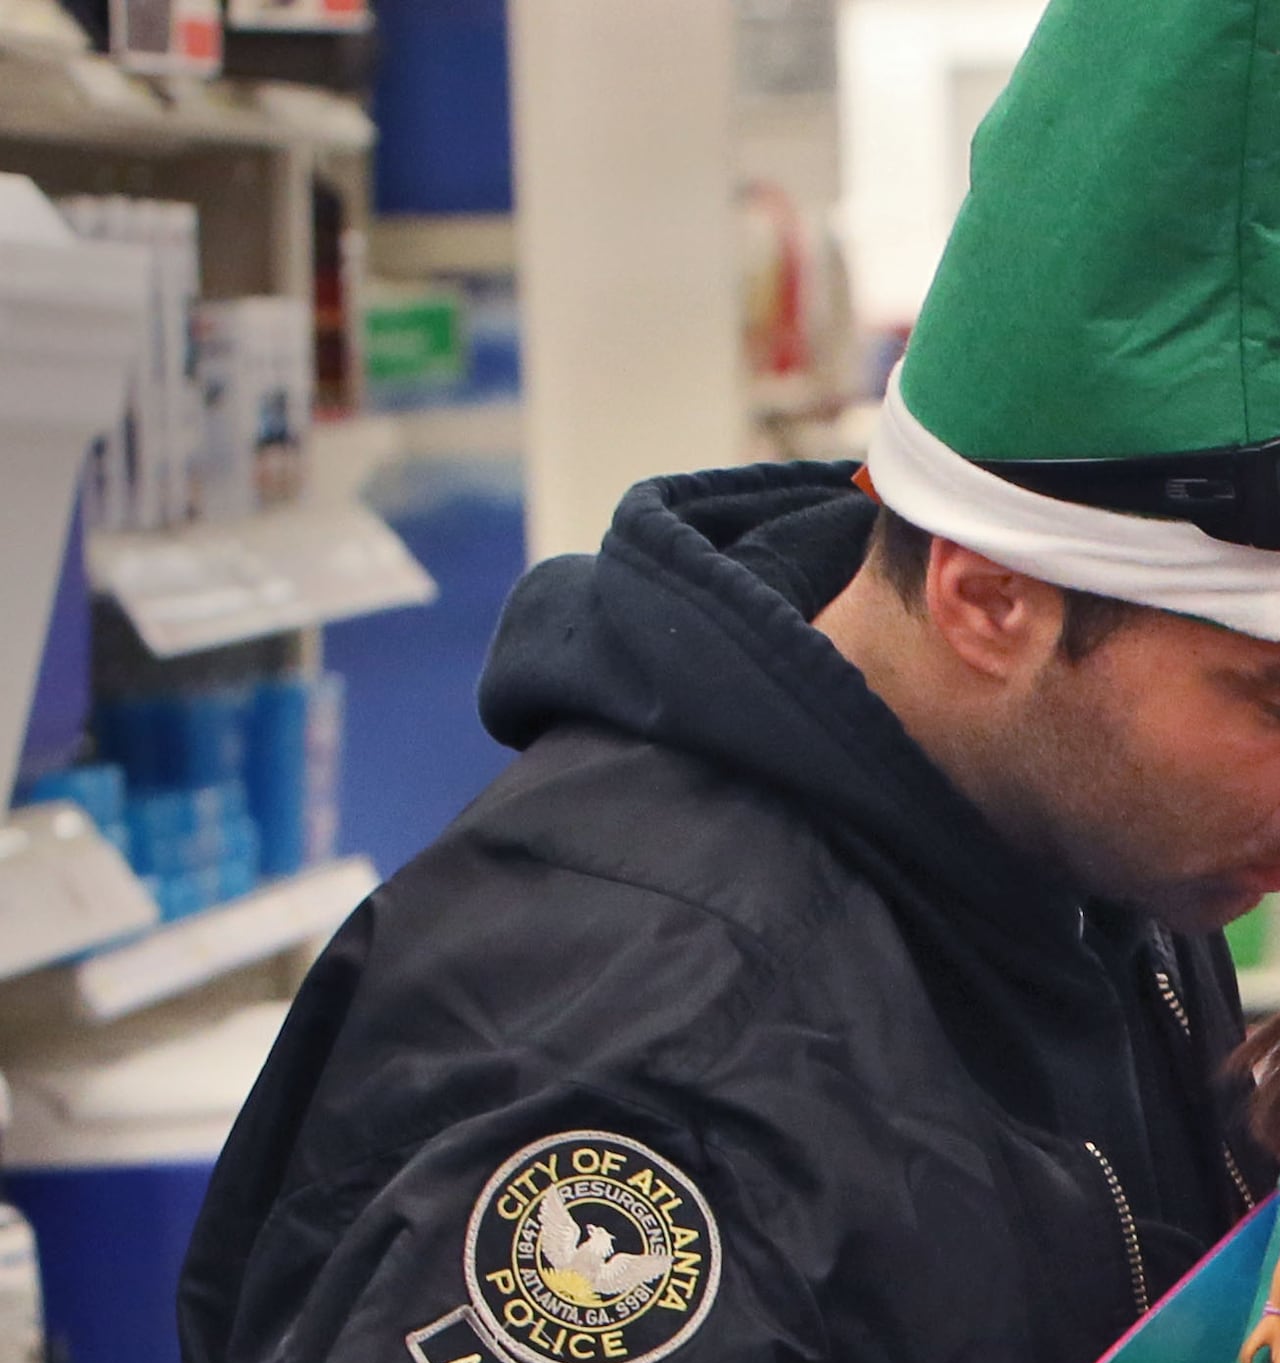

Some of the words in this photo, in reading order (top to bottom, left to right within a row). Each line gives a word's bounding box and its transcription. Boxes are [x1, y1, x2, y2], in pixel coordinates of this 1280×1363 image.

[497, 1154, 559, 1220] CITY
[572, 1148, 627, 1176] OF
[627, 1168, 702, 1312] ATLANTA
[518, 1218, 539, 1259] 1847
[559, 1181, 666, 1257] RESURGENS
[486, 1267, 628, 1359] POLICE
[586, 1310, 615, 1325] GA.
